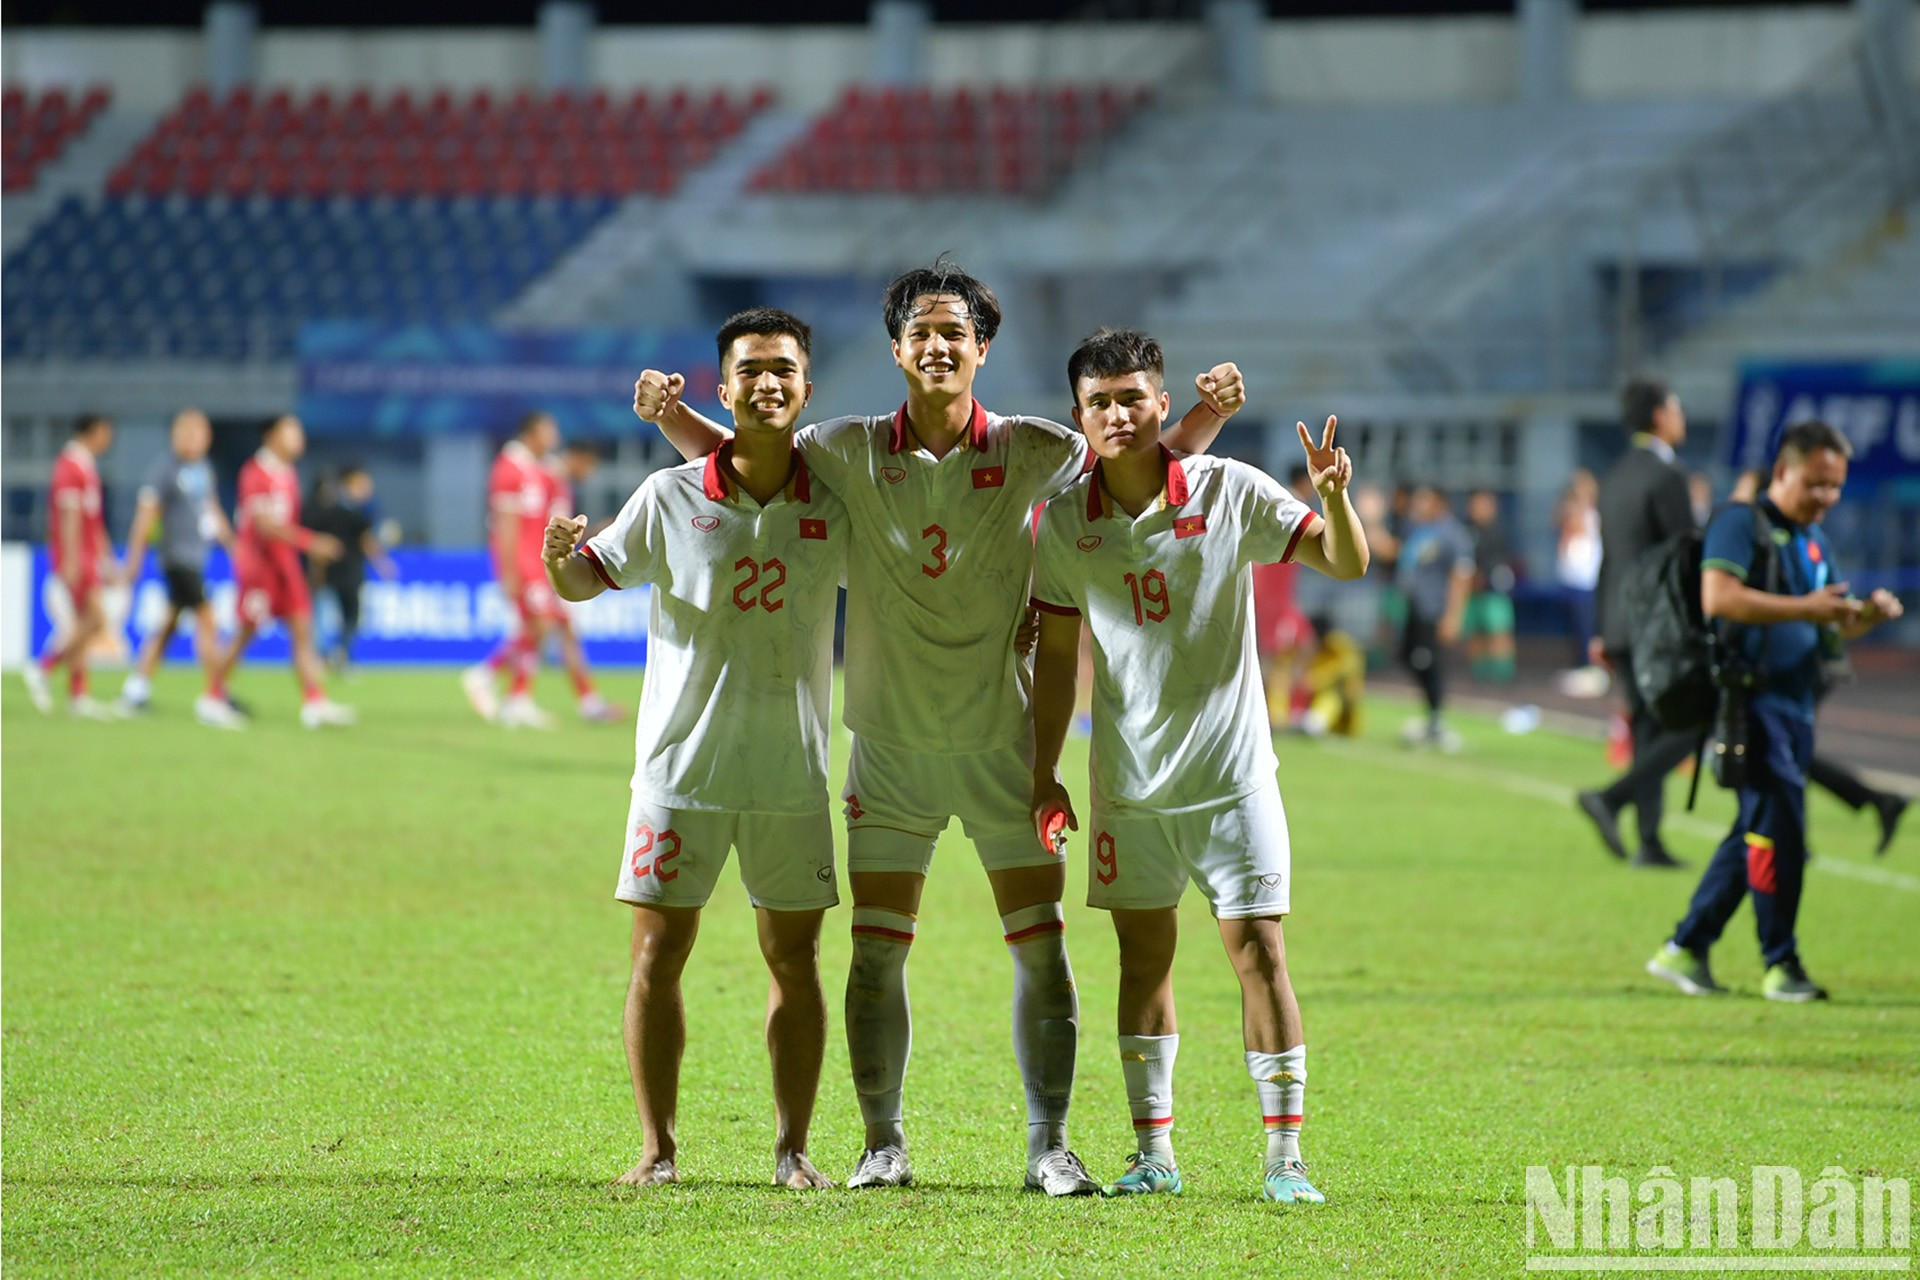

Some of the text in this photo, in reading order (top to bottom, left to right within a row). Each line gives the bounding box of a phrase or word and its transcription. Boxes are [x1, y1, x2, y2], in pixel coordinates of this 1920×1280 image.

[922, 523, 947, 579] 3
[733, 556, 786, 613] 22
[1123, 568, 1171, 627] 19
[631, 823, 682, 883] 22
